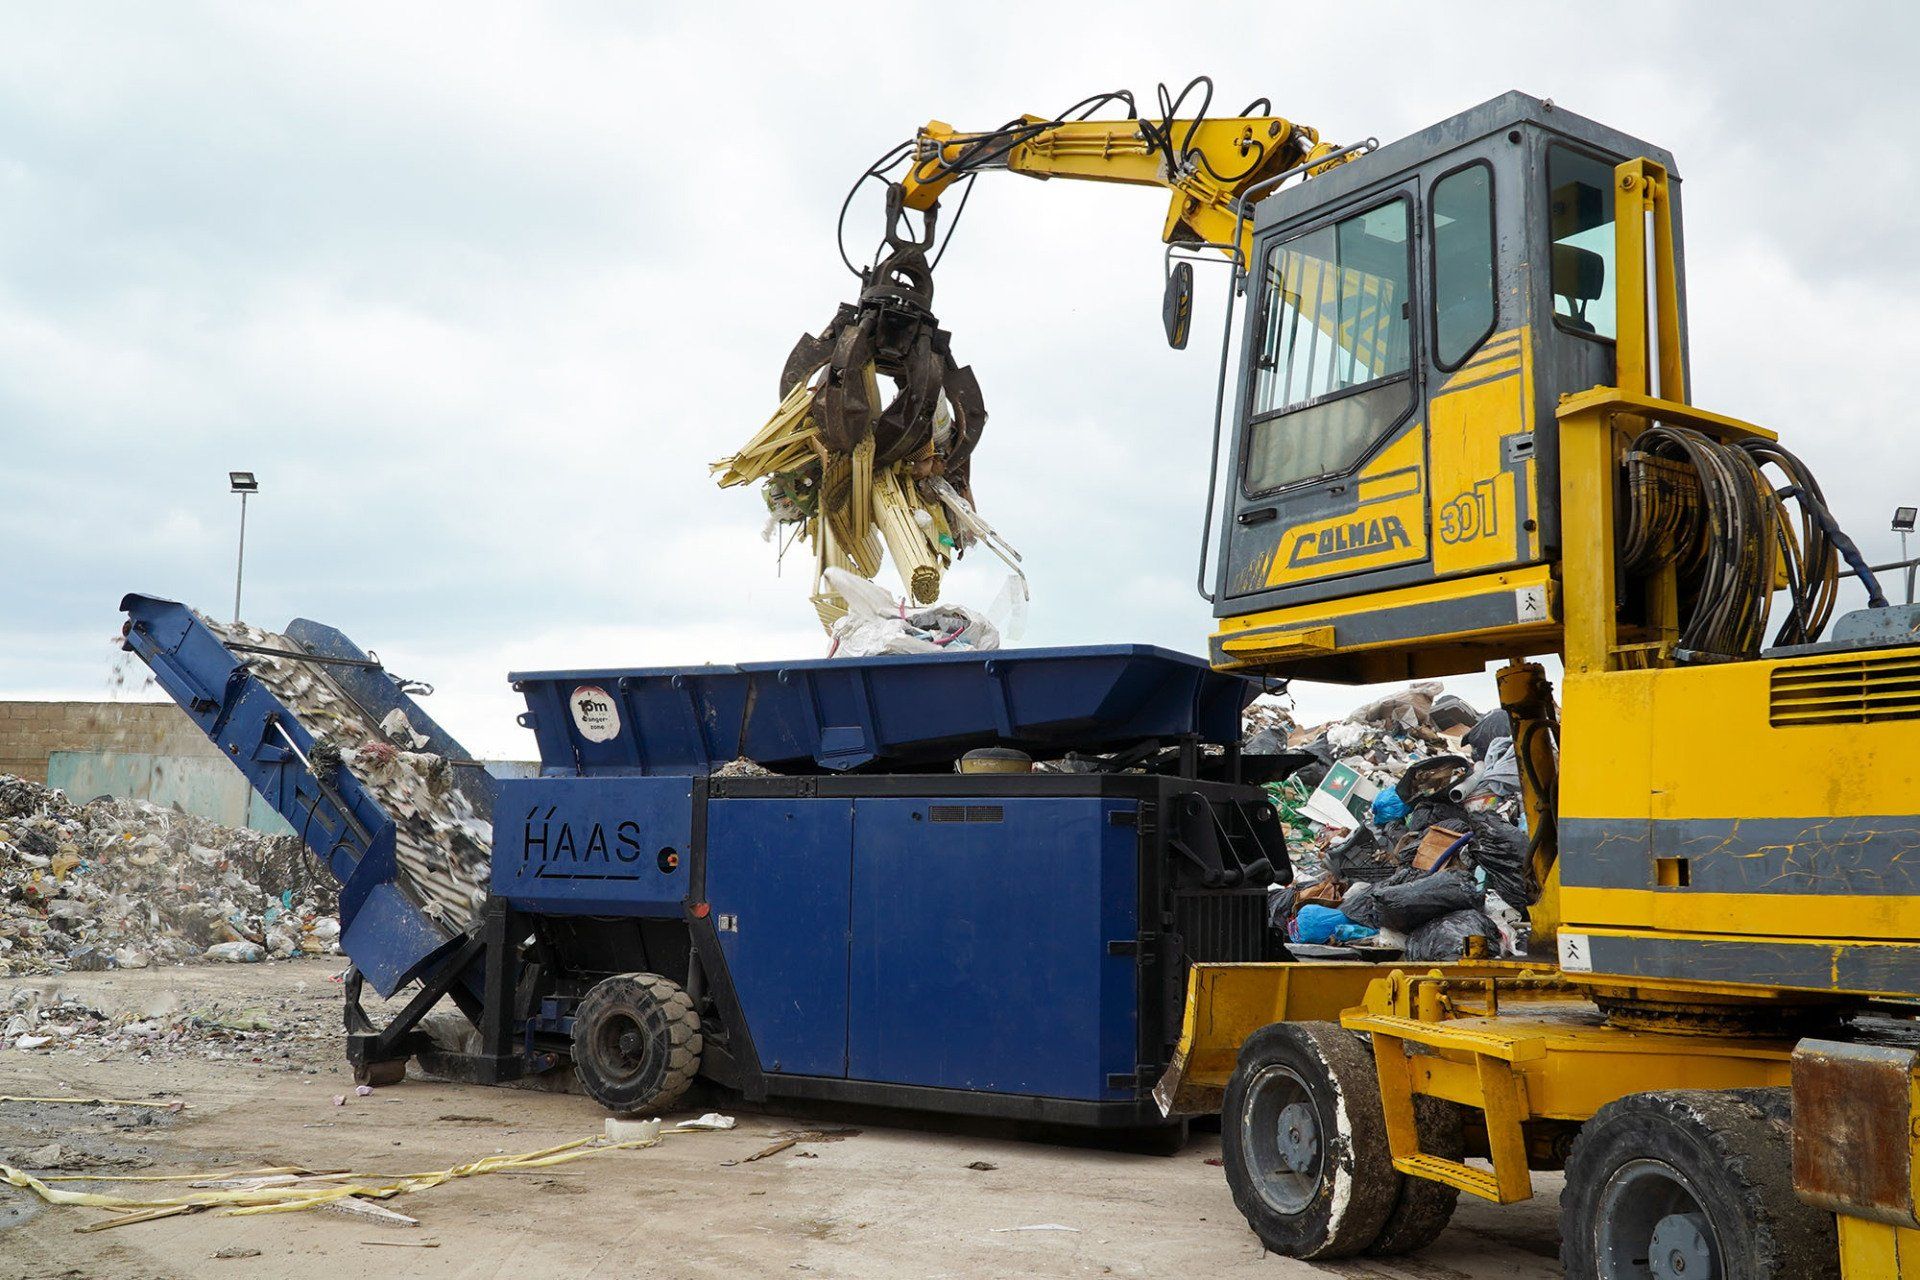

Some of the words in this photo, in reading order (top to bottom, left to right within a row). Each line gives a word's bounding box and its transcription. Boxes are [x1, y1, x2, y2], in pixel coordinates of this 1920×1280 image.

[1440, 478, 1497, 544] 301
[1288, 515, 1412, 569] COLMAR
[523, 820, 641, 863] HAAS
